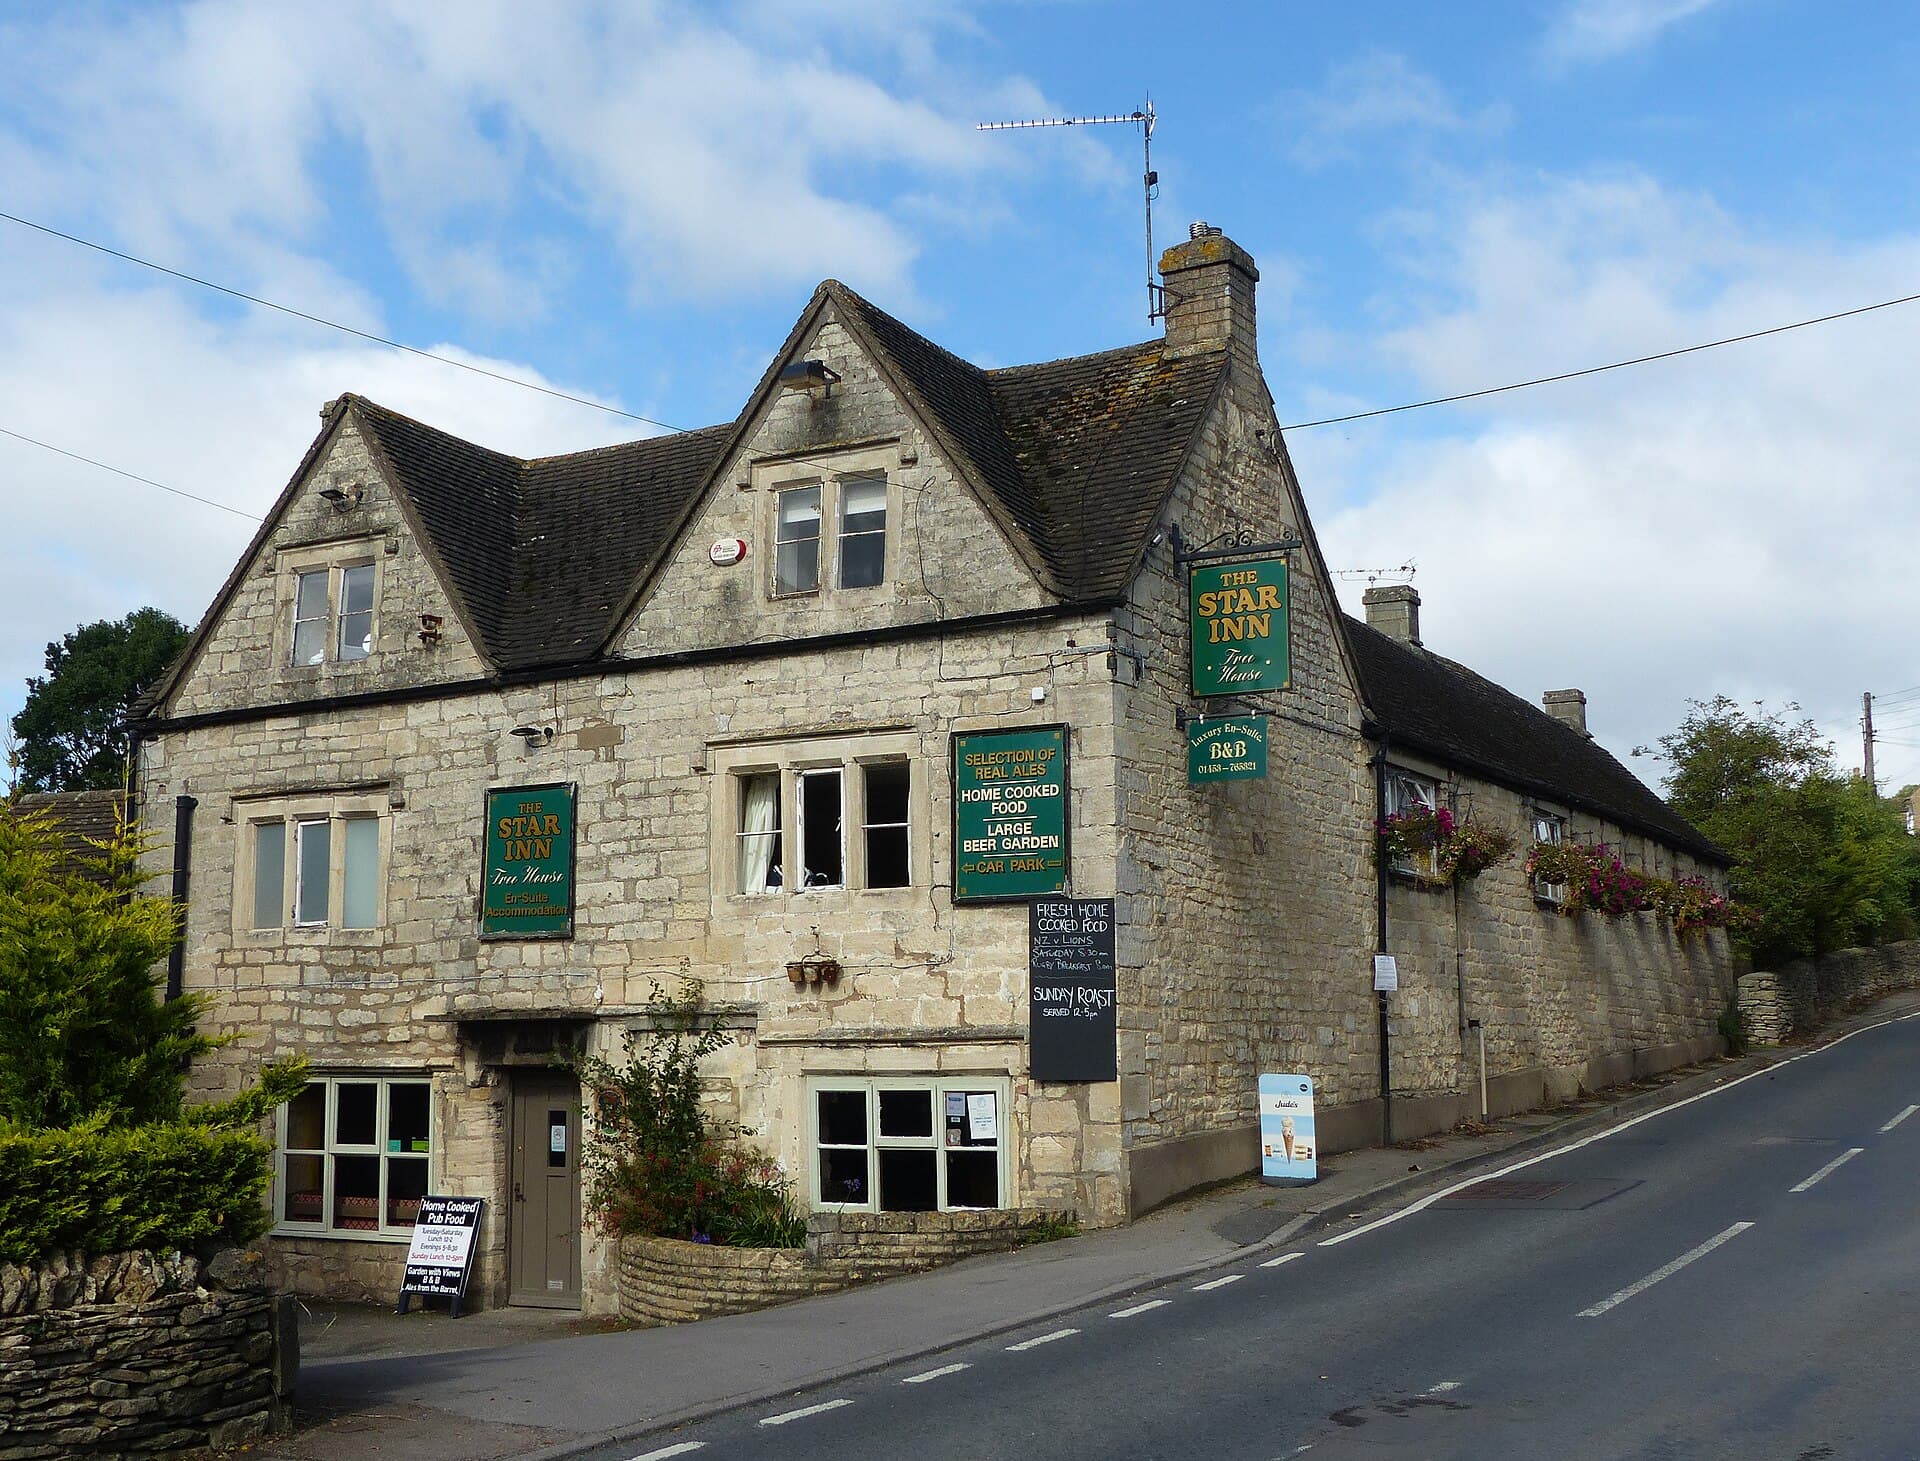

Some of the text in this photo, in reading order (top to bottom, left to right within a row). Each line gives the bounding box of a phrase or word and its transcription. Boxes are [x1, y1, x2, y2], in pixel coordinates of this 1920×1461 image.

[1220, 570, 1258, 587] THE
[1198, 585, 1281, 617] STAR
[1208, 613, 1271, 643] INN
[1219, 648, 1255, 666] Free
[1217, 665, 1263, 684] House
[1191, 726, 1222, 747] Luxury
[965, 748, 1056, 766] SELECTION OF
[1209, 740, 1247, 759] B&B
[975, 764, 1046, 780] REAL ALES
[961, 784, 1060, 802] HOME COOKED
[518, 801, 542, 814] THE
[991, 801, 1028, 815] FOOD
[498, 814, 561, 839] STAR
[987, 822, 1032, 837] LARGE
[504, 838, 552, 862] INN
[963, 835, 1059, 853] BEER GARDEN
[977, 858, 1045, 874] CAR PARK
[521, 865, 564, 884] House
[504, 891, 549, 904] En-Suite
[486, 905, 568, 918] Accommodation
[1036, 903, 1109, 918] FRESH HOME
[1038, 918, 1108, 933] COOKED FOOD
[1033, 936, 1051, 945] NZ
[1033, 986, 1114, 1009] SUNDAY ROAST
[1042, 1008, 1070, 1017] SERVED
[422, 1200, 476, 1213] Home Cooked
[427, 1213, 466, 1225] Pub Food
[411, 1252, 428, 1260] Sunday
[407, 1266, 461, 1277] Garden with Views
[405, 1283, 417, 1291] Ales
[417, 1283, 429, 1291] from
[430, 1284, 439, 1292] the
